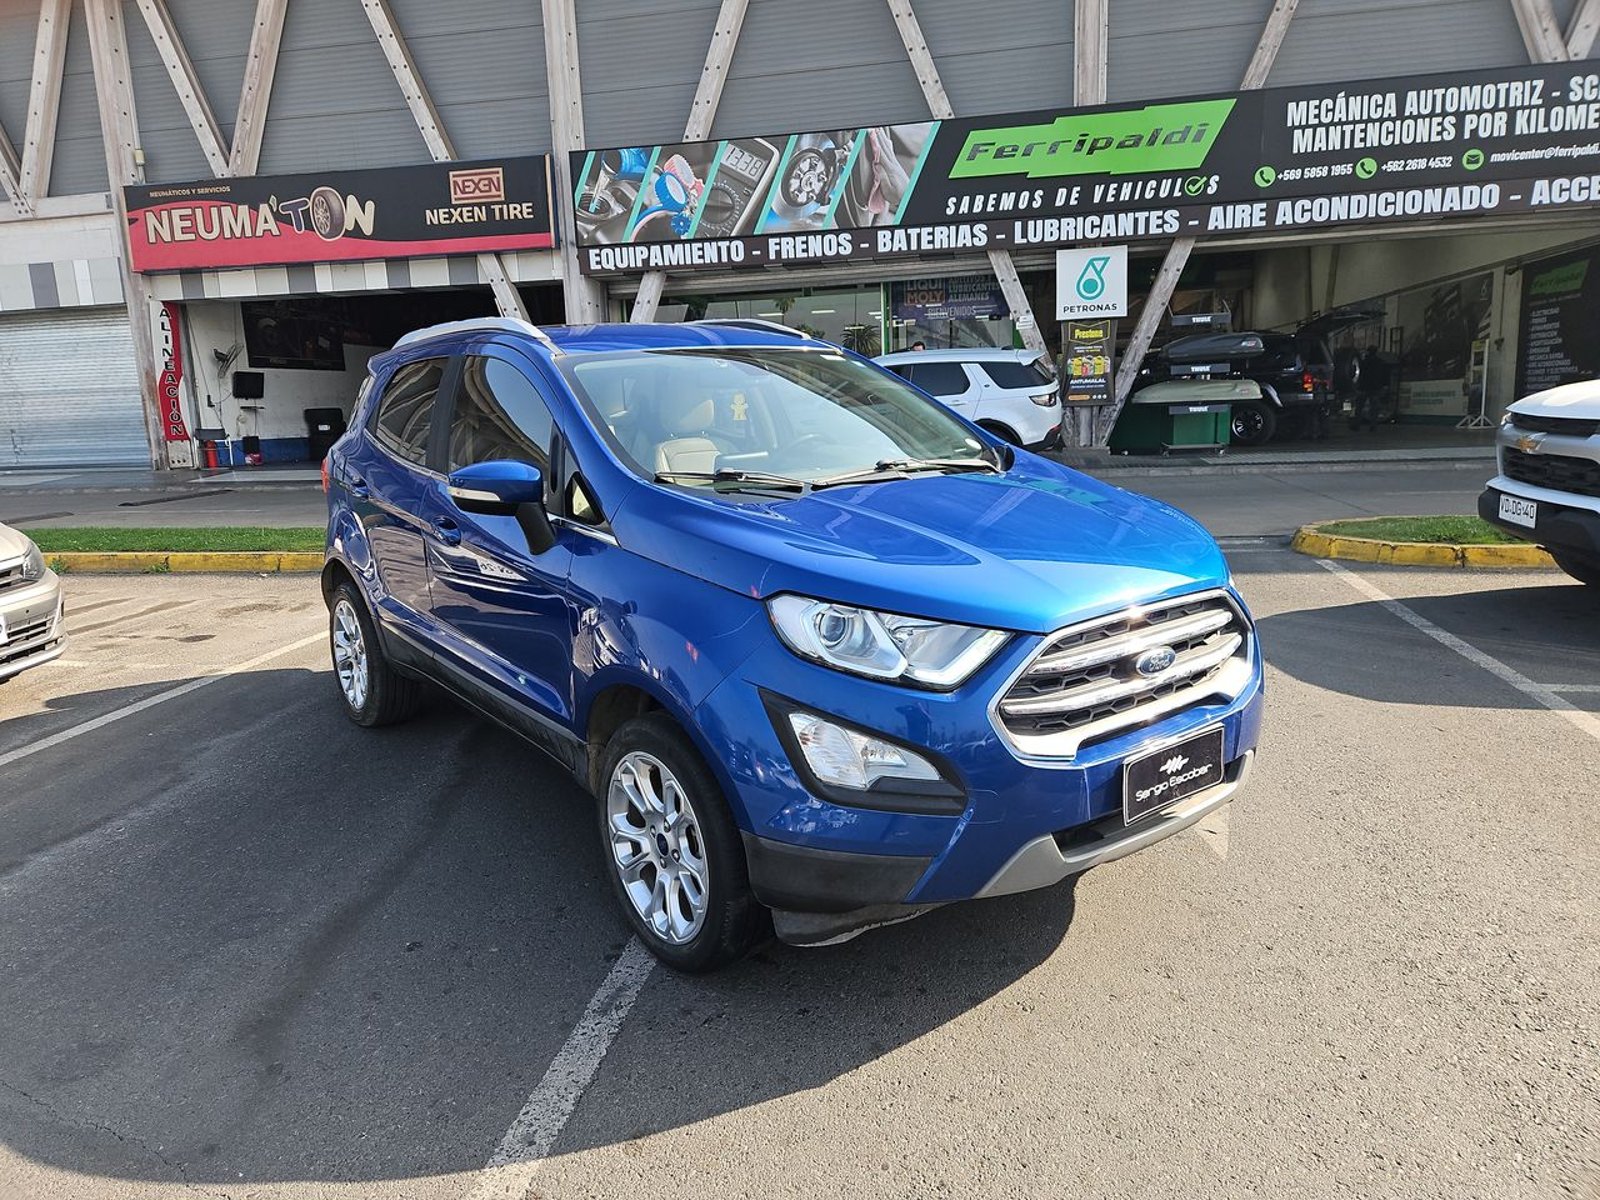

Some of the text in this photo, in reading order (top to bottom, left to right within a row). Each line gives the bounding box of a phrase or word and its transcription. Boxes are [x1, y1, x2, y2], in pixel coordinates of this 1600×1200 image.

[1287, 91, 1397, 127] MECÁNICA
[1404, 79, 1545, 114] AUTOMOTRIZ
[1569, 74, 1600, 101] SC
[966, 122, 1210, 161] Ferripaldi
[1292, 116, 1456, 154] MANTENCIONES
[1463, 111, 1507, 139] POR
[1277, 166, 1302, 182] +569
[1330, 163, 1354, 177] 1955
[1381, 159, 1404, 173] +562
[197, 186, 231, 195] SERVICIOS
[453, 177, 501, 195] NEXEN
[946, 190, 1044, 216] SABEMOS
[1055, 187, 1080, 207] DE
[425, 202, 535, 225] NEXEN TIRE
[589, 241, 745, 271] EQUIPAMIENTO
[769, 234, 852, 260] FRENOS
[877, 223, 988, 253] BATERIAS
[1013, 209, 1180, 244] LUBRICANTES
[1207, 203, 1267, 231] AIRE
[1275, 183, 1500, 226] ACONDICIONADO
[907, 279, 942, 290] LIQUI
[907, 291, 942, 303] MOLY
[1062, 302, 1117, 314] PETRONAS
[158, 307, 183, 436] ALINEACIÓN
